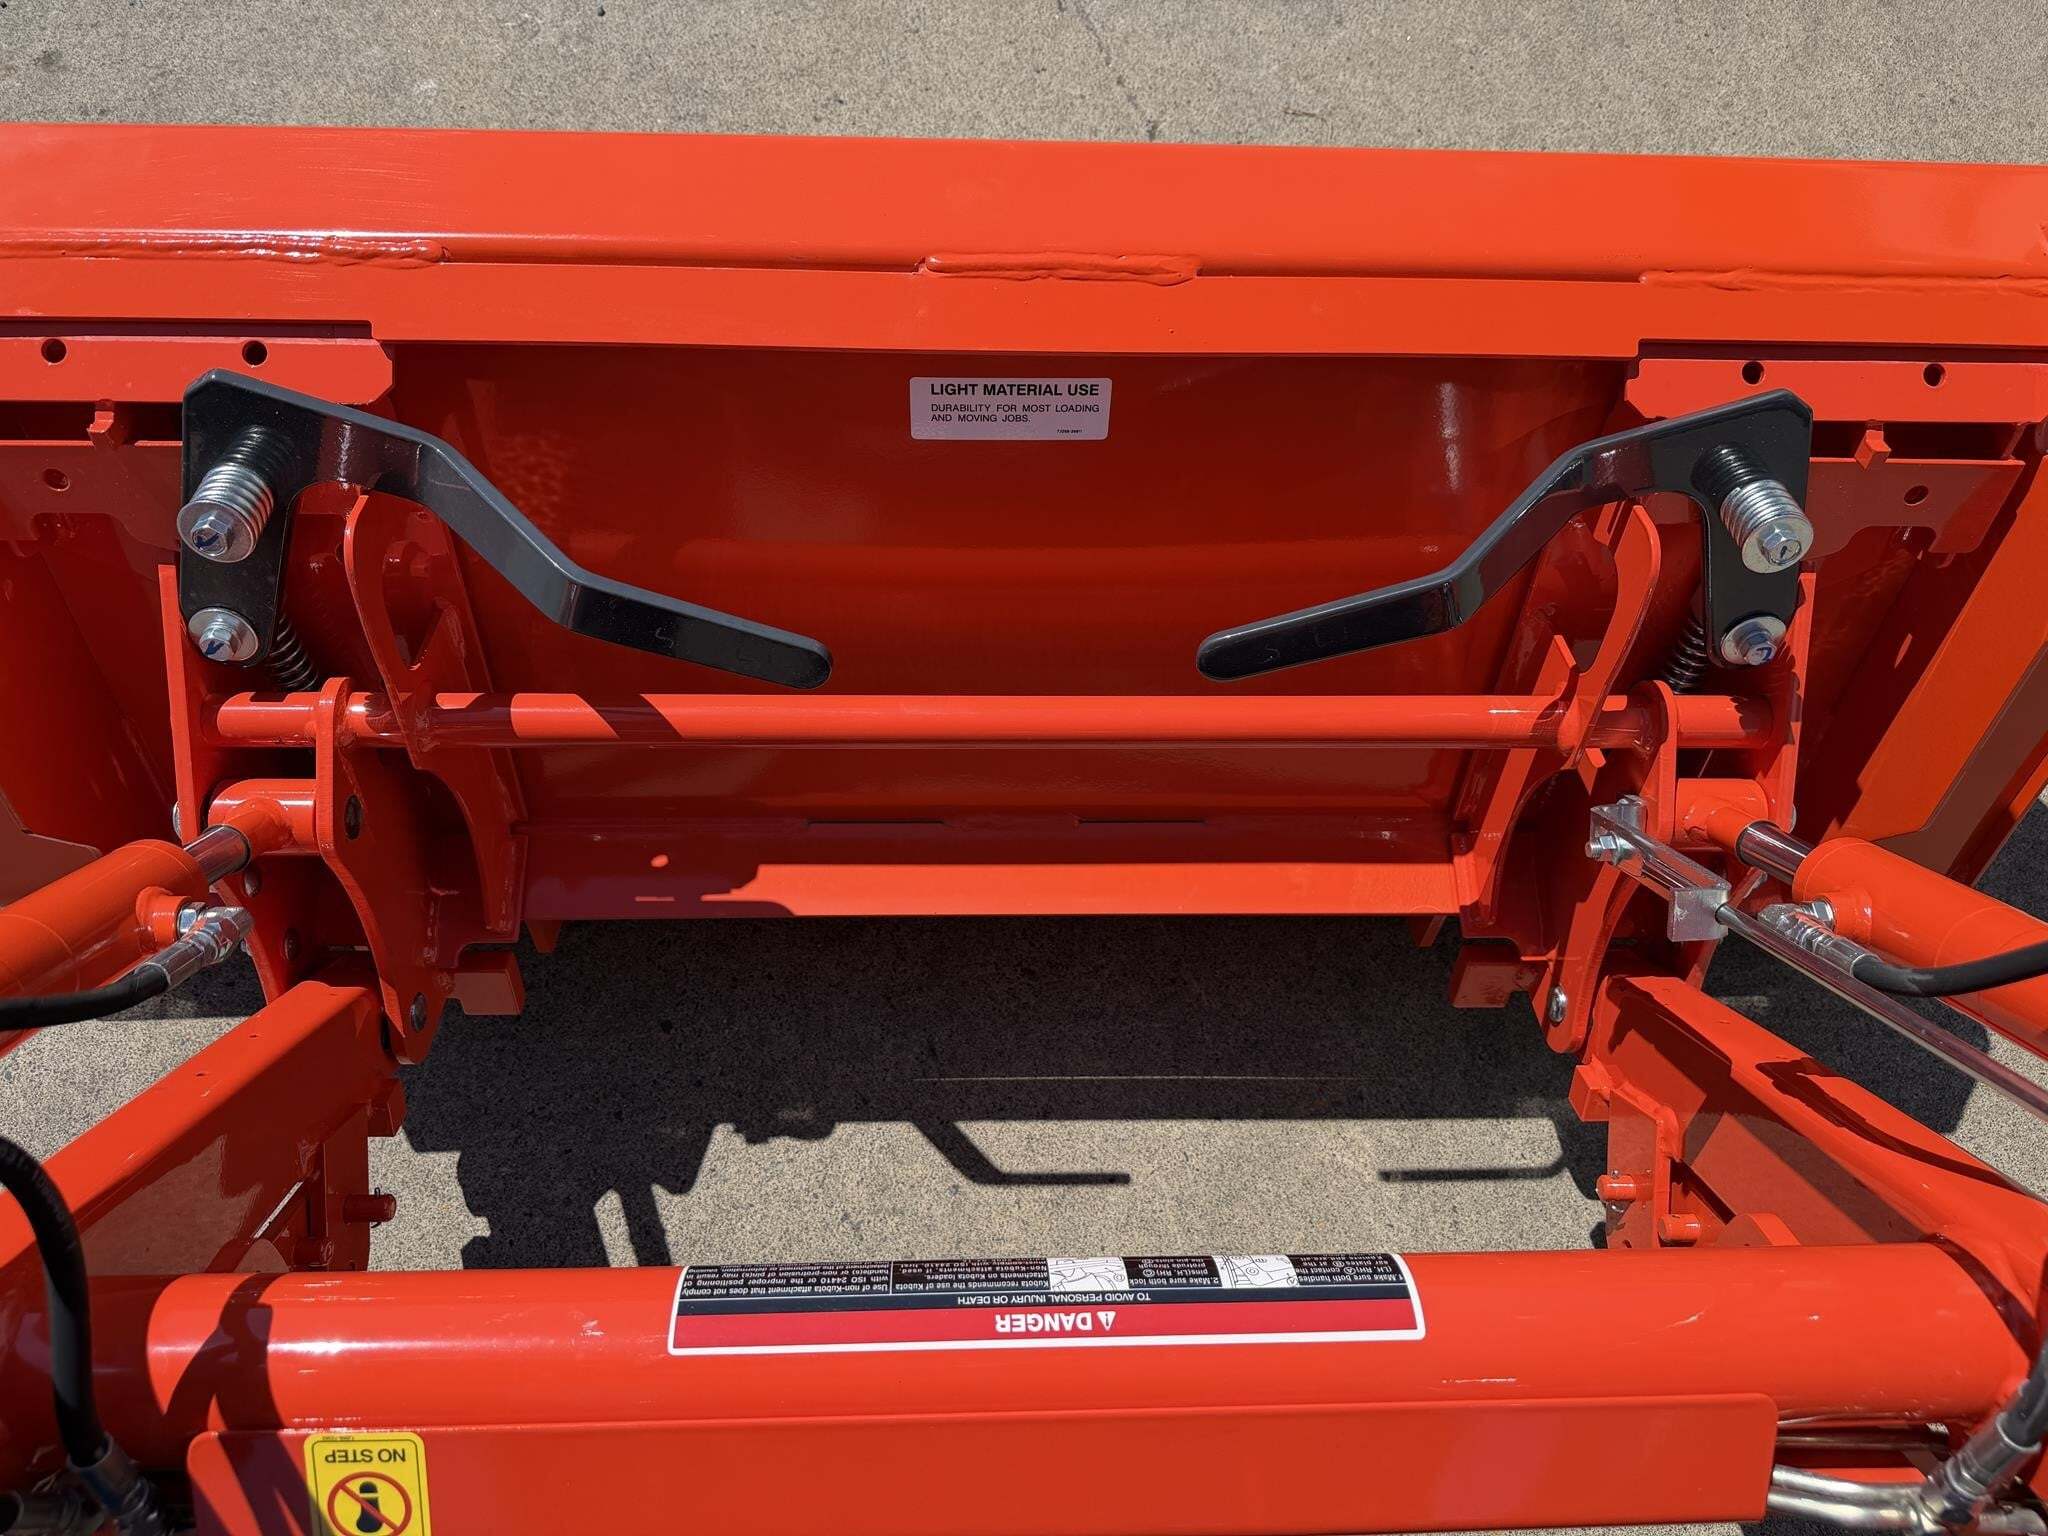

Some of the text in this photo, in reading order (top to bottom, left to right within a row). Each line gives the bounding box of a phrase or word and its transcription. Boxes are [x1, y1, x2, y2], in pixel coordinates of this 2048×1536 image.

[931, 384, 1100, 396] LIGHT MATERIAL USE
[931, 404, 1100, 412] DURABILITY FOR MOST LOADING
[931, 414, 1031, 422] AND MOVING JOBS.
[790, 1277, 804, 1285] the
[820, 1276, 847, 1284] 24410
[851, 1276, 867, 1284] ISO
[870, 1275, 888, 1283] with
[958, 1273, 986, 1281] Kubota
[1297, 1275, 1331, 1283] handles
[683, 1280, 694, 1288] of
[697, 1279, 745, 1287] positioning
[953, 1282, 966, 1290] the
[968, 1281, 1019, 1289] recommends
[1021, 1280, 1049, 1288] Kubota
[1130, 1278, 1147, 1286] lock
[681, 1284, 888, 1297] Use of non-Kubota attachment that does not comply
[926, 1283, 935, 1291] of
[958, 1296, 990, 1304] DEATH
[1010, 1295, 1046, 1303] INJURY
[1048, 1293, 1102, 1302] PERSONAL
[1105, 1293, 1135, 1301] AVOID
[995, 1312, 1092, 1332] DANGER
[325, 1448, 406, 1464] NO STEP
